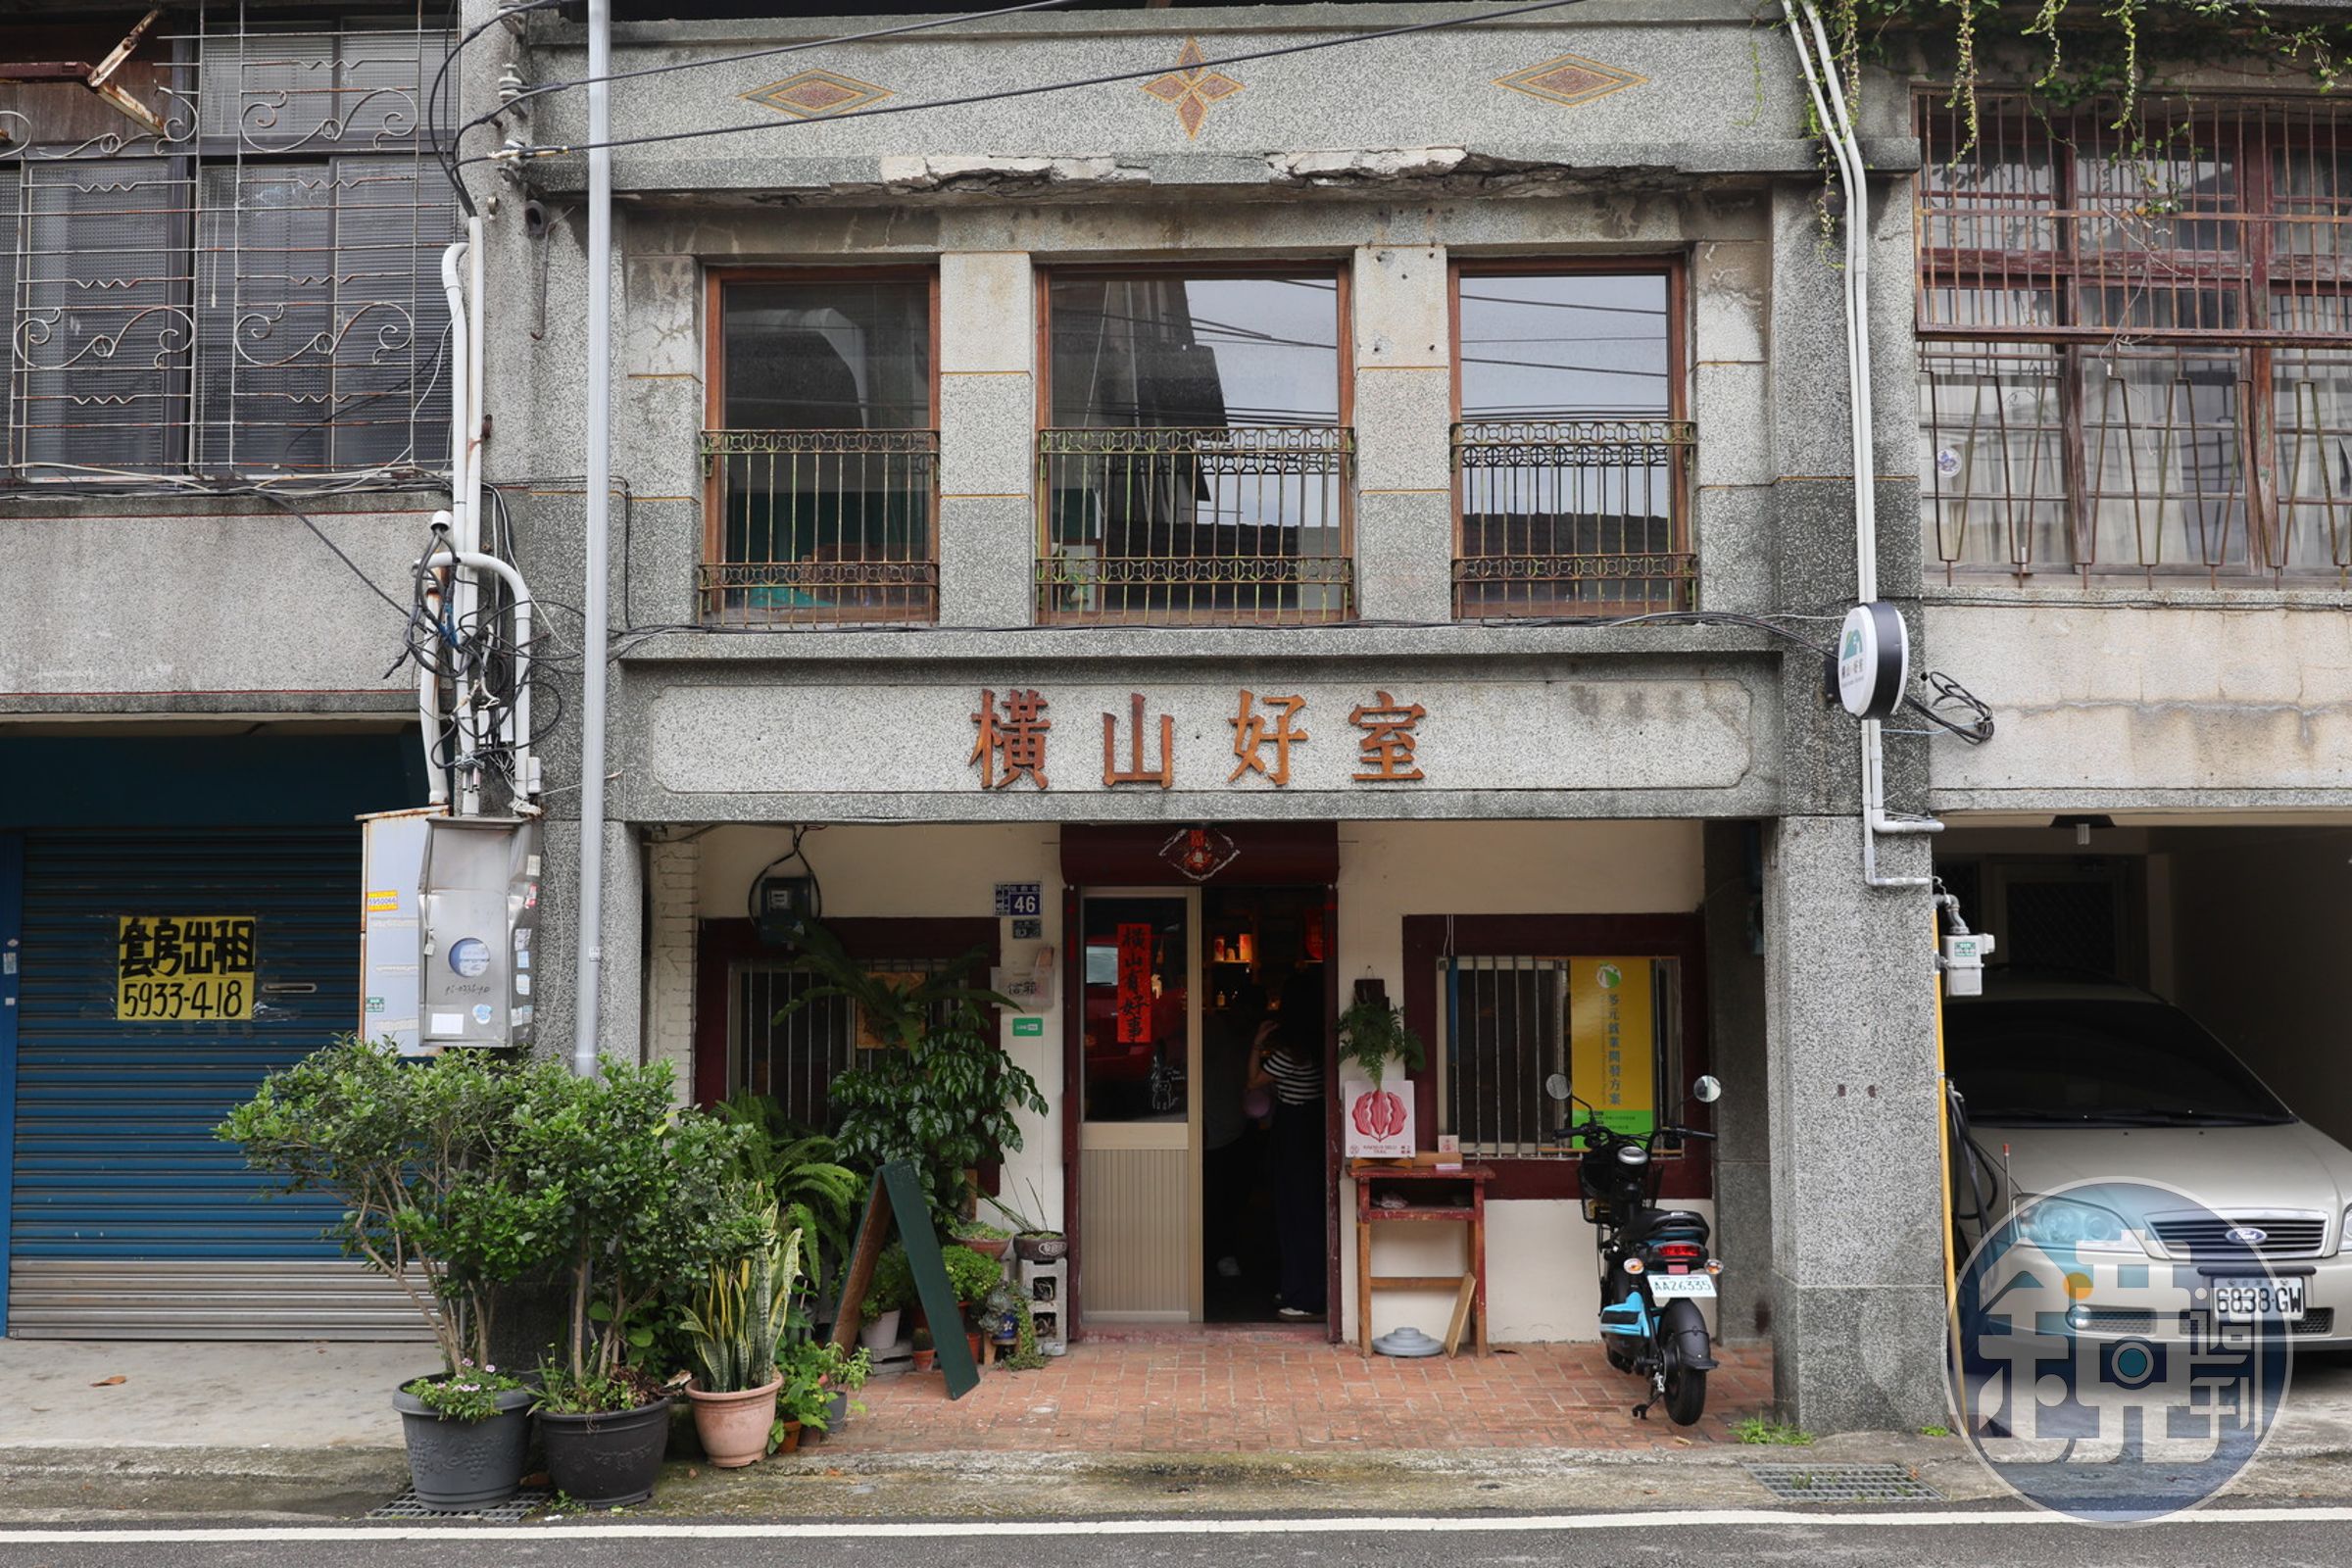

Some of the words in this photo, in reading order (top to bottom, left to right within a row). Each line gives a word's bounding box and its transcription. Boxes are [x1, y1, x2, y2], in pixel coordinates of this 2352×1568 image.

[968, 688, 1426, 788] 橫山好室
[1014, 895, 1036, 913] 46
[120, 917, 255, 979] 套房出租
[123, 980, 243, 1019] 5933-418
